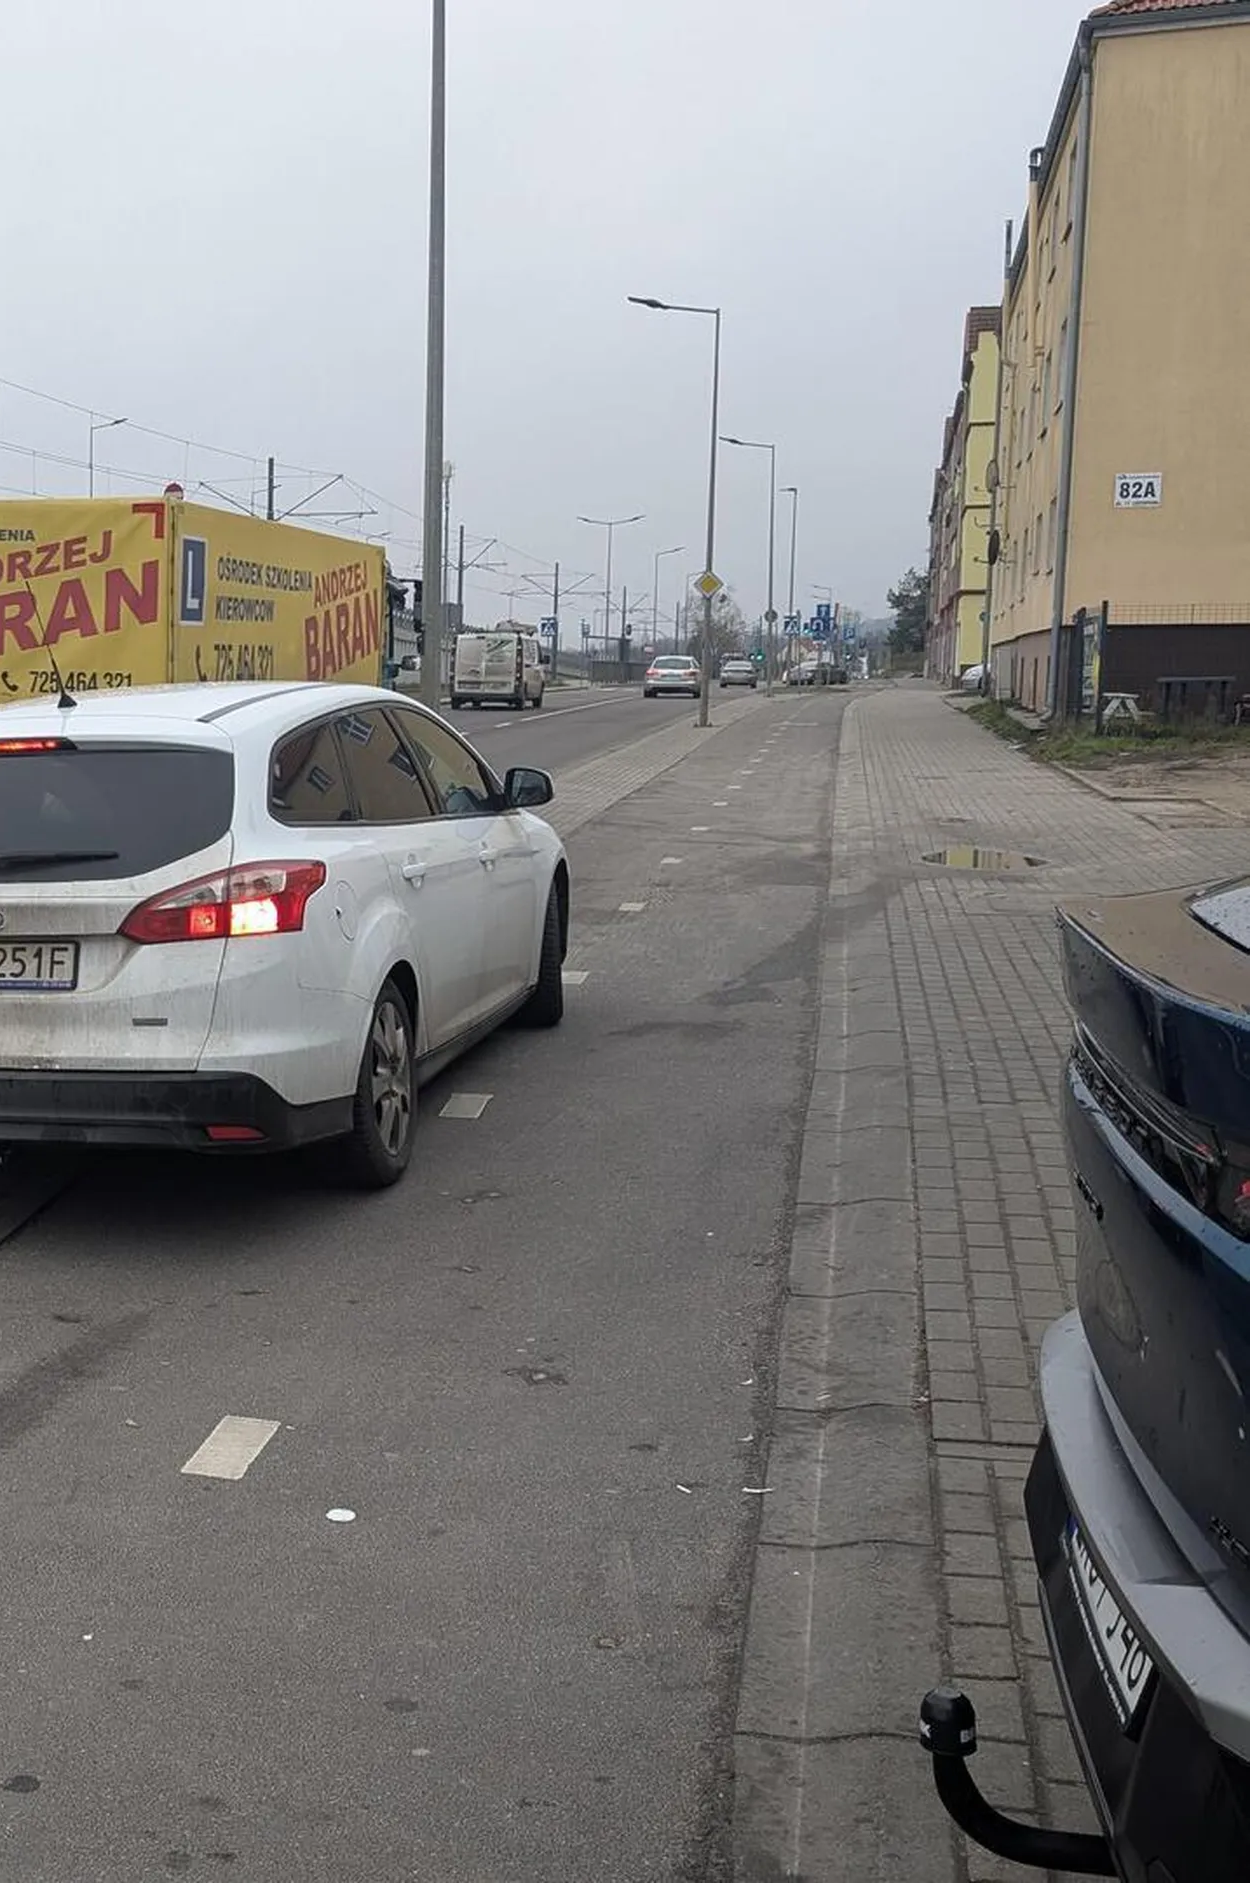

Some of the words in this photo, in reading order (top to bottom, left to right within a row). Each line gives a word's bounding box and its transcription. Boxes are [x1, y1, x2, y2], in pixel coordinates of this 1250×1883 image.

[1119, 481, 1156, 499] 82A
[186, 550, 200, 609] L
[314, 560, 368, 608] ANDRZEJ
[305, 588, 378, 681] BARAN
[29, 671, 59, 693] 725
[64, 672, 98, 692] 464
[103, 673, 132, 687] 321
